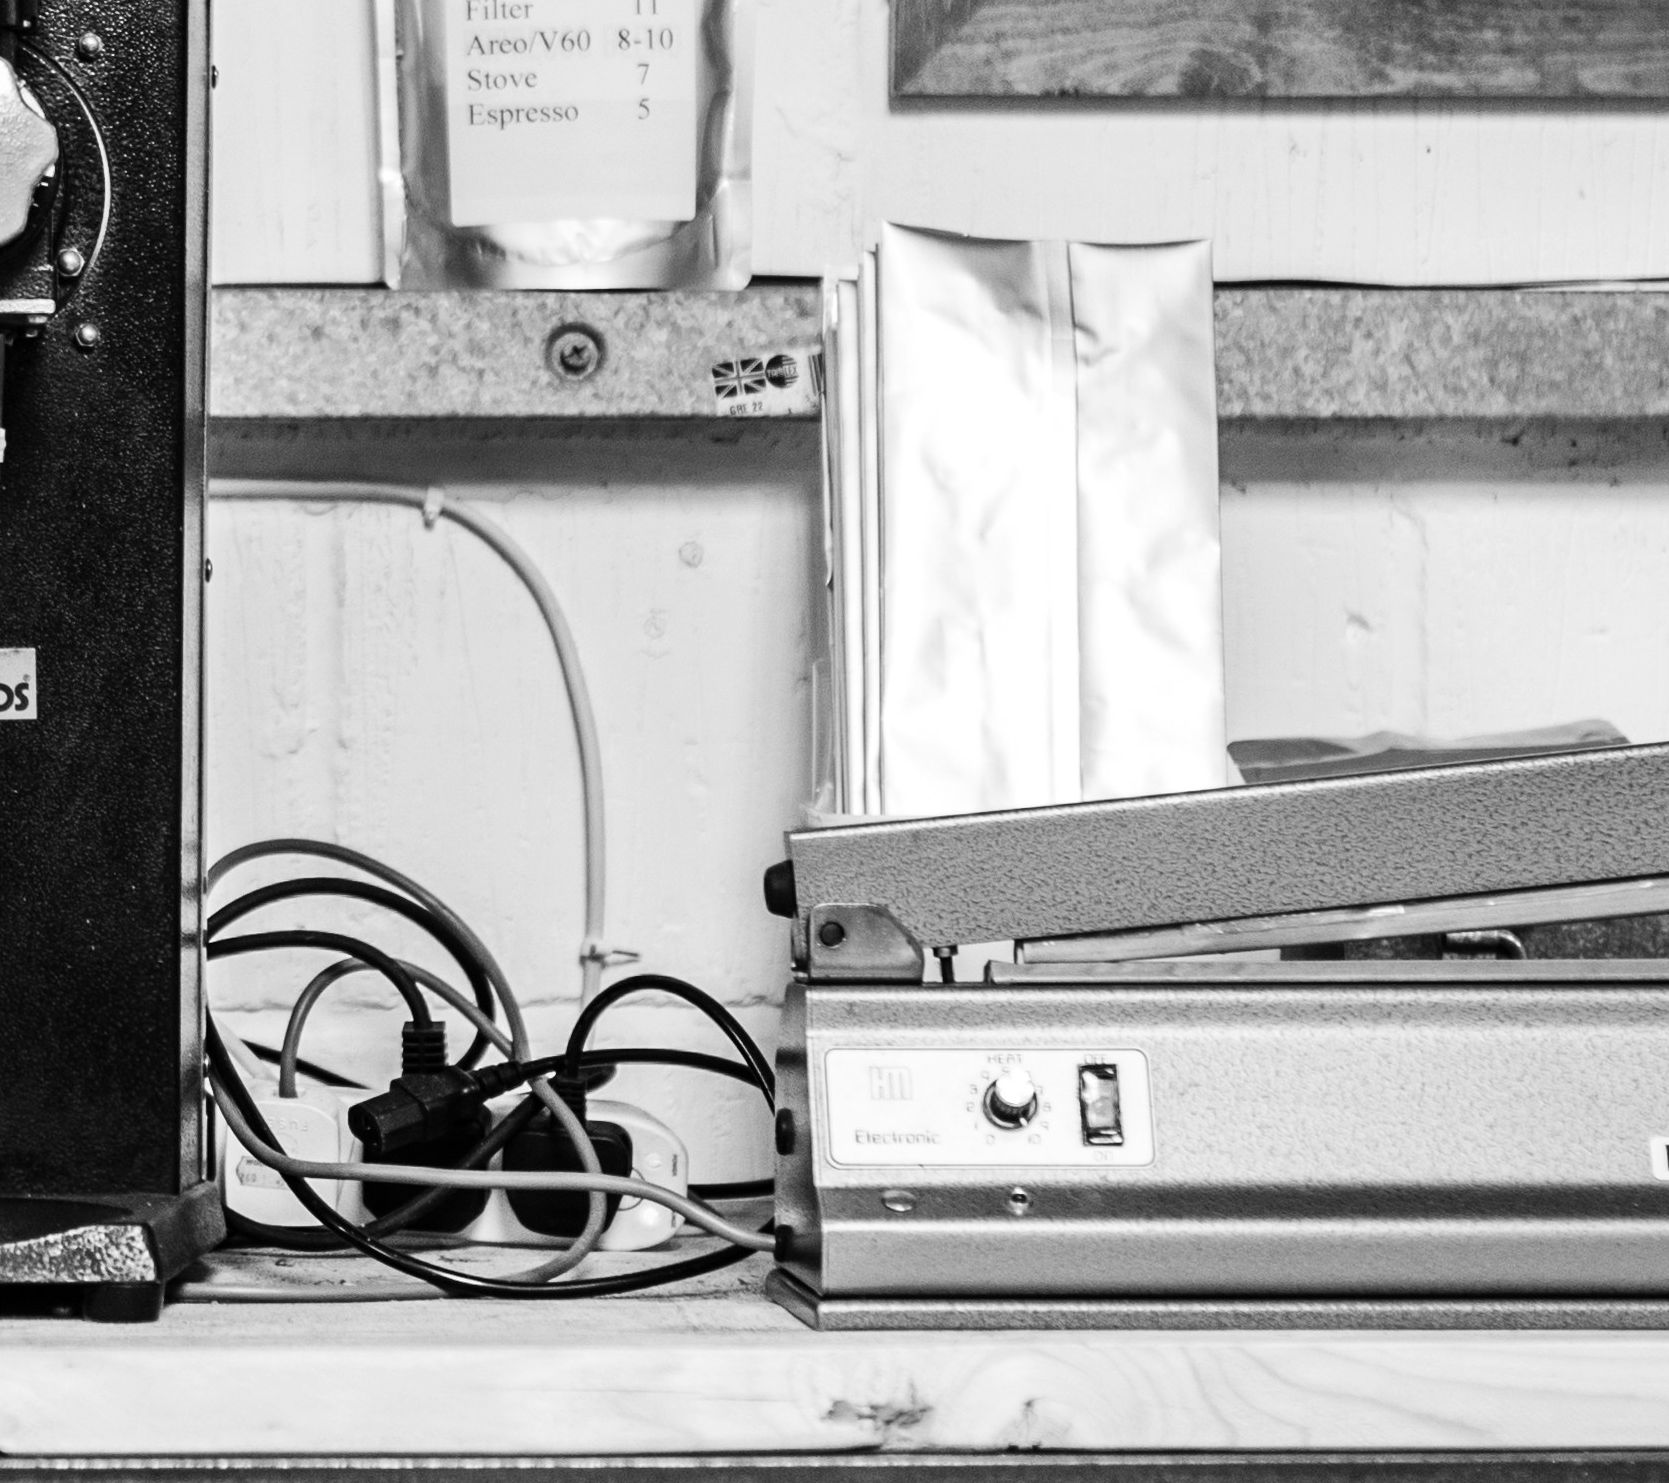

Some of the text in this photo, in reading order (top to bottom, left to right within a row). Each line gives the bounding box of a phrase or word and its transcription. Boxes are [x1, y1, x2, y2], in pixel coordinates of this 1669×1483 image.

[465, 0, 533, 22] Filter
[466, 29, 673, 57] Areo/V60 8-10
[466, 65, 649, 92] Stove 7
[467, 100, 649, 130] Espresso 5
[987, 1053, 1023, 1065] HEAT
[855, 1129, 941, 1145] Electronic
